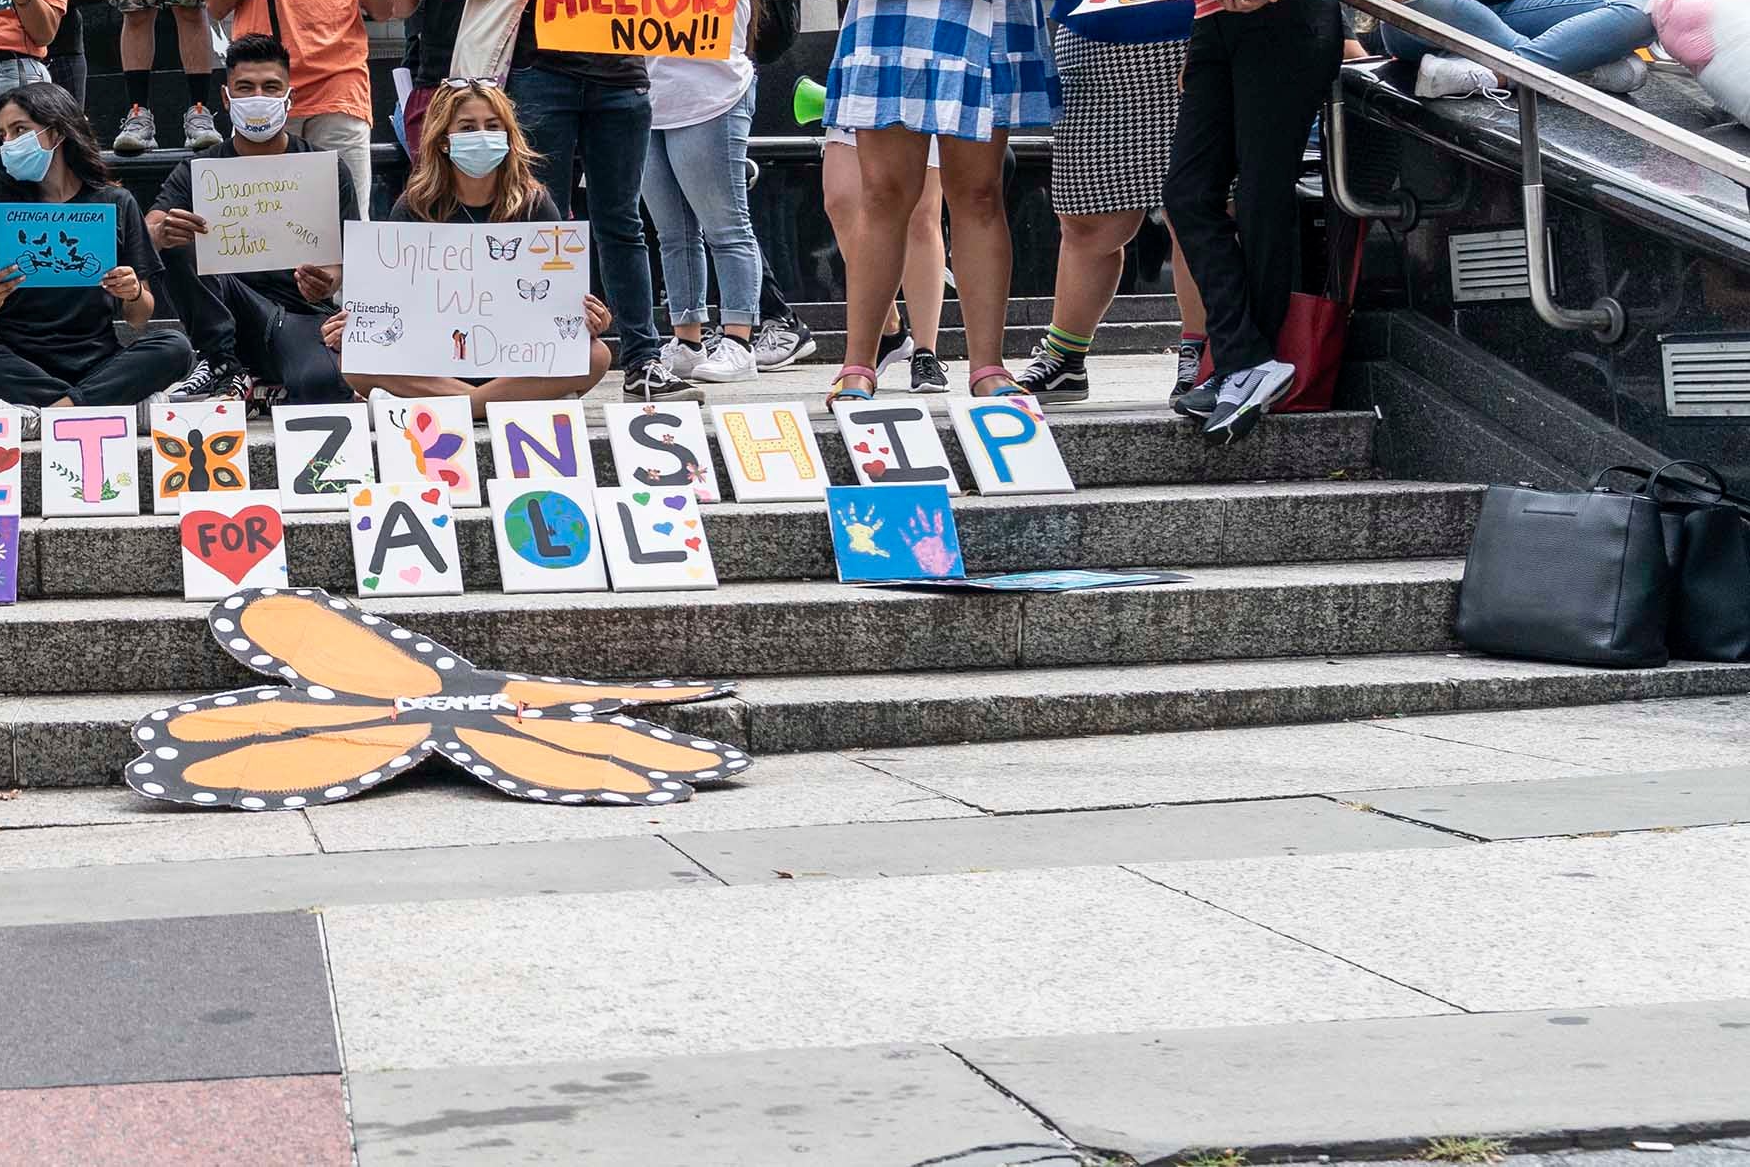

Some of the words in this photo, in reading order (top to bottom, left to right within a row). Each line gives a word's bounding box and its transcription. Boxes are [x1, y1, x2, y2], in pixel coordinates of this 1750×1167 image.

[611, 14, 719, 56] NOW!!
[200, 169, 299, 202] Dreamers
[7, 211, 49, 223] CHINGA
[51, 212, 66, 223] LA
[66, 212, 105, 223] MIGRA
[221, 204, 249, 218] are
[254, 198, 283, 214] the
[377, 228, 474, 285] United
[344, 300, 400, 319] Citizenship
[436, 277, 494, 316] We
[472, 324, 557, 374] Dream
[198, 516, 275, 557] FOR
[368, 498, 688, 575] ALL
[396, 693, 517, 712] DREAMER
